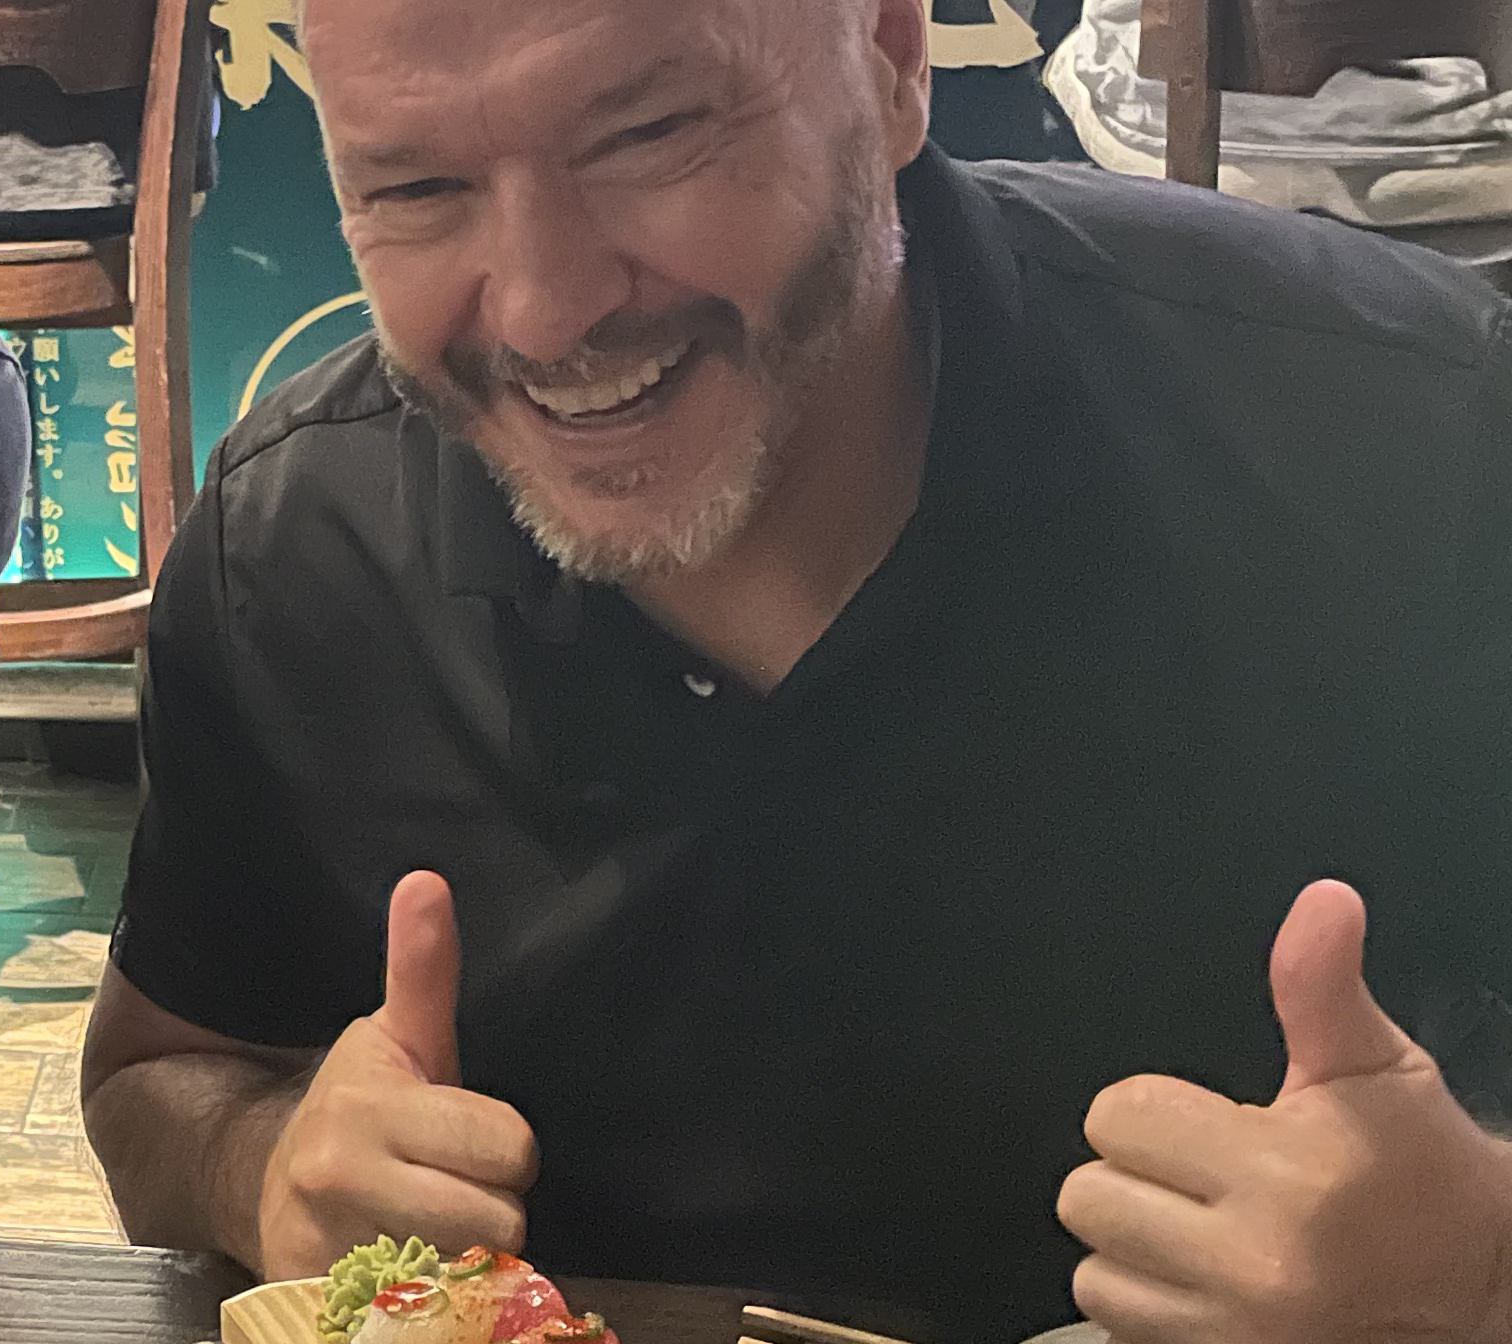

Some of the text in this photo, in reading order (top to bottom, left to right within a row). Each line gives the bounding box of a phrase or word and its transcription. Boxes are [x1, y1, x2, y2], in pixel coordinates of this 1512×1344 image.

[33, 328, 65, 581] 願いします。ありが
